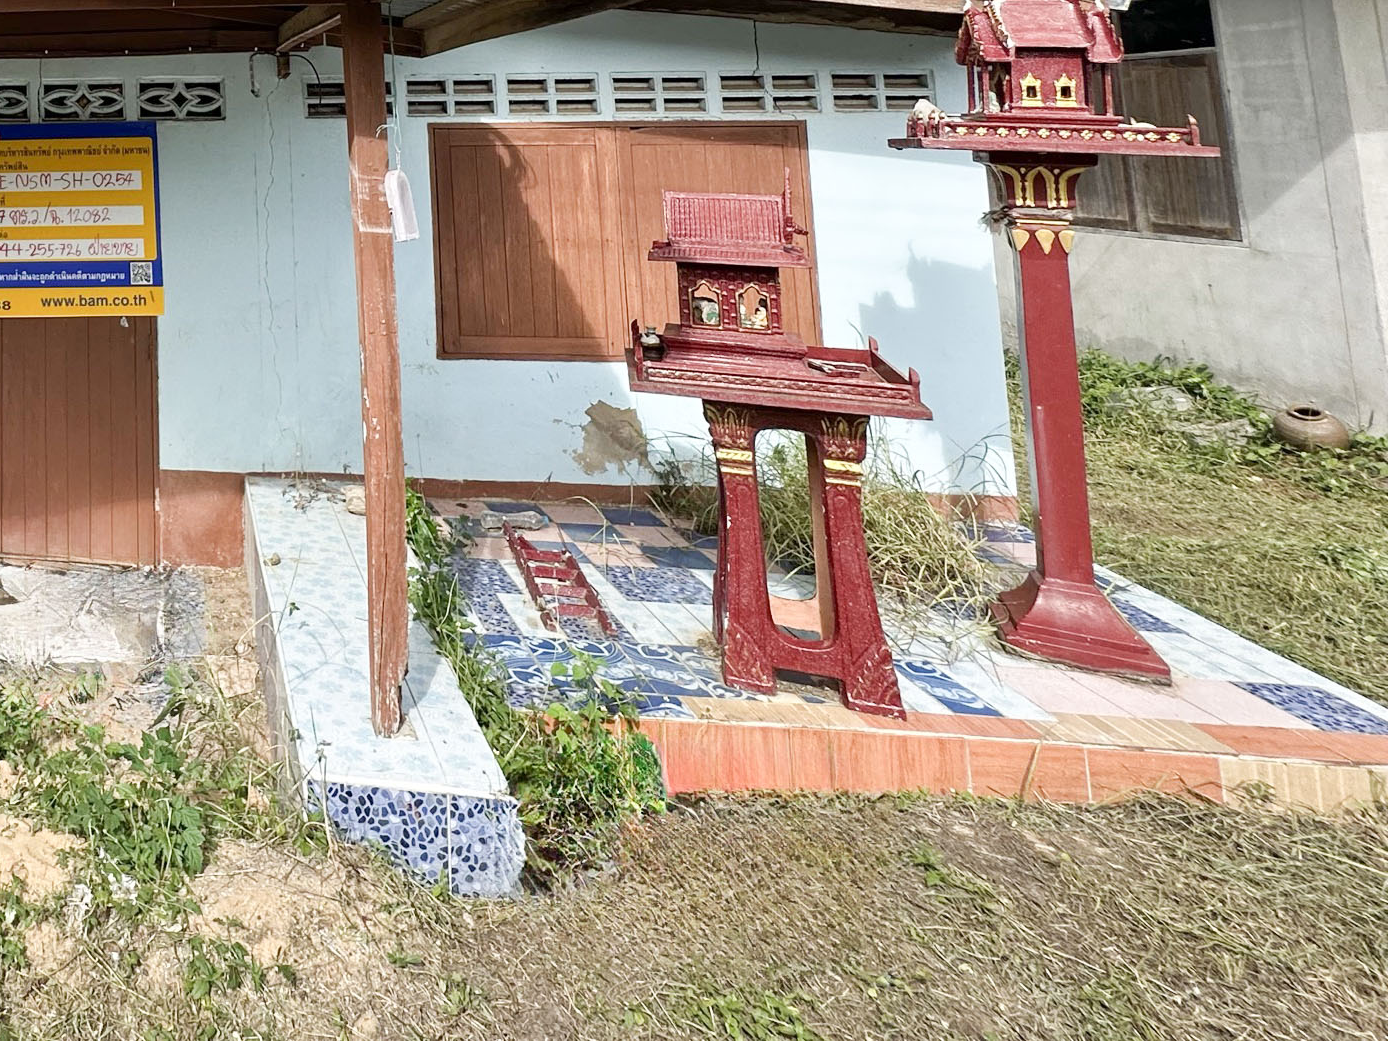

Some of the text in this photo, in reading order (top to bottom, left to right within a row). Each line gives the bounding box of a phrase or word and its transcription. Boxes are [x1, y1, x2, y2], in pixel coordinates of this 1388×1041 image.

[103, 145, 121, 155] จำกัด
[122, 146, 150, 157] (มหาชน)
[67, 207, 112, 225] 12082
[41, 294, 147, 308] www.bam.co.th
